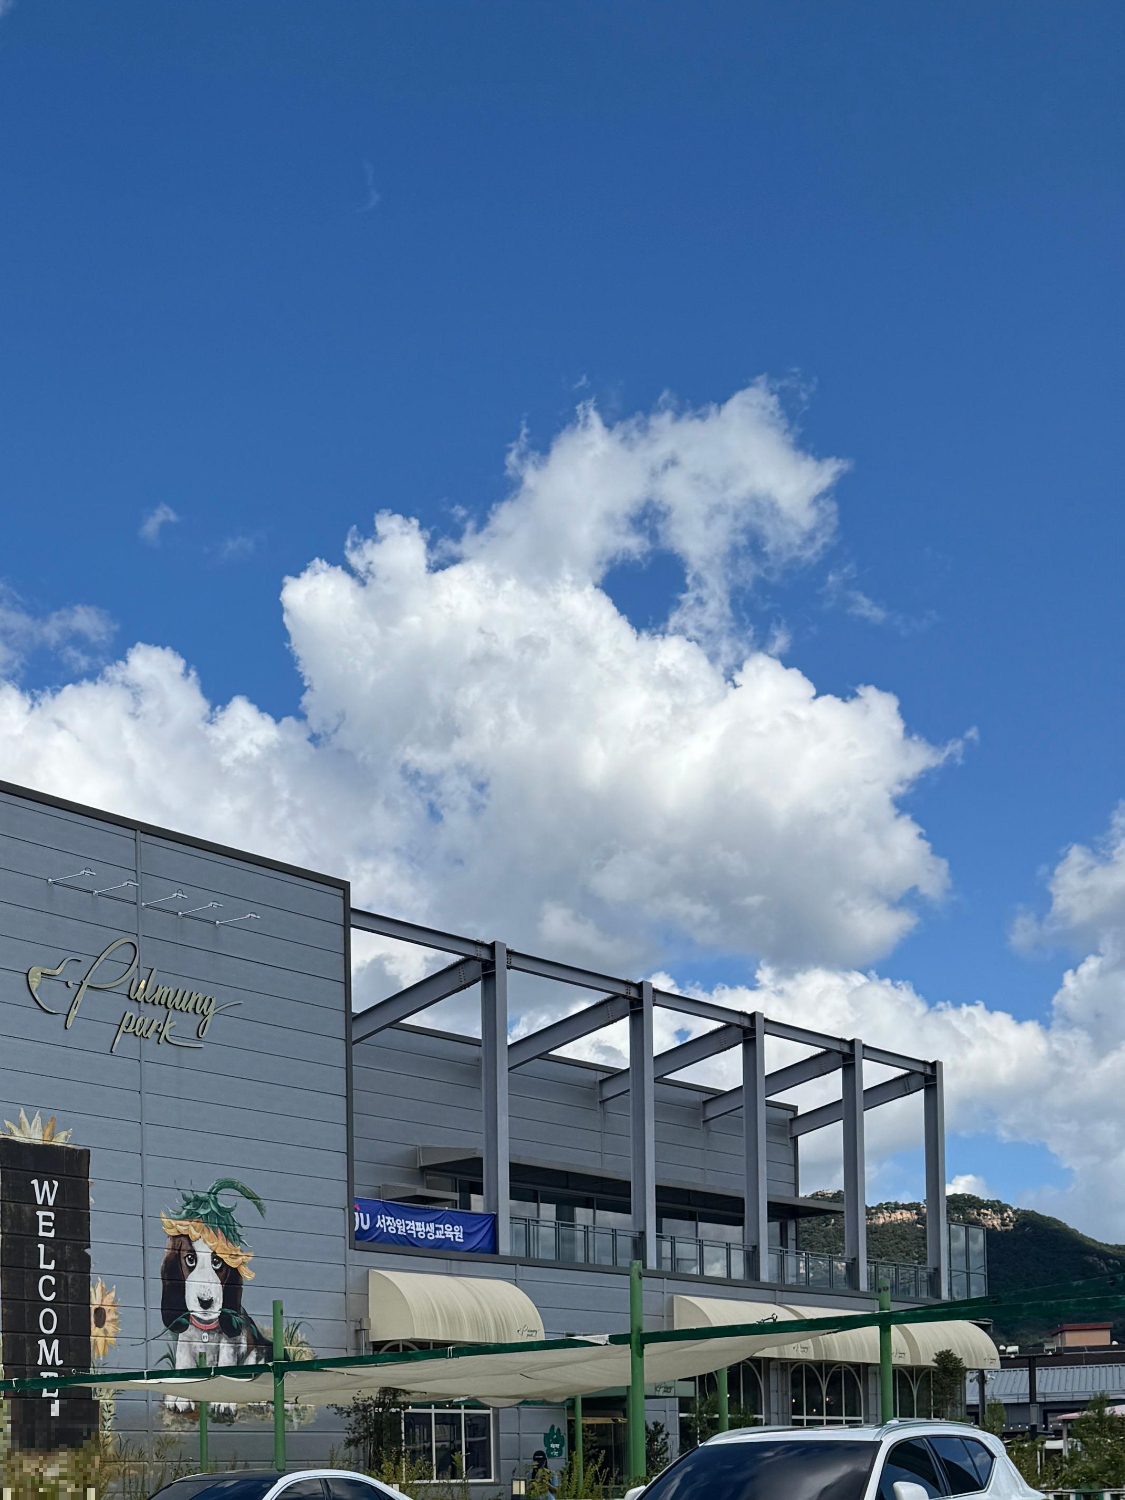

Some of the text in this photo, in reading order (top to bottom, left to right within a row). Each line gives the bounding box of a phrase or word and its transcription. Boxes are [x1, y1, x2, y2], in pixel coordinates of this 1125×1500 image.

[65, 936, 244, 1039] Pulmung
[110, 1010, 204, 1053] park
[30, 1178, 64, 1398] WELCOME
